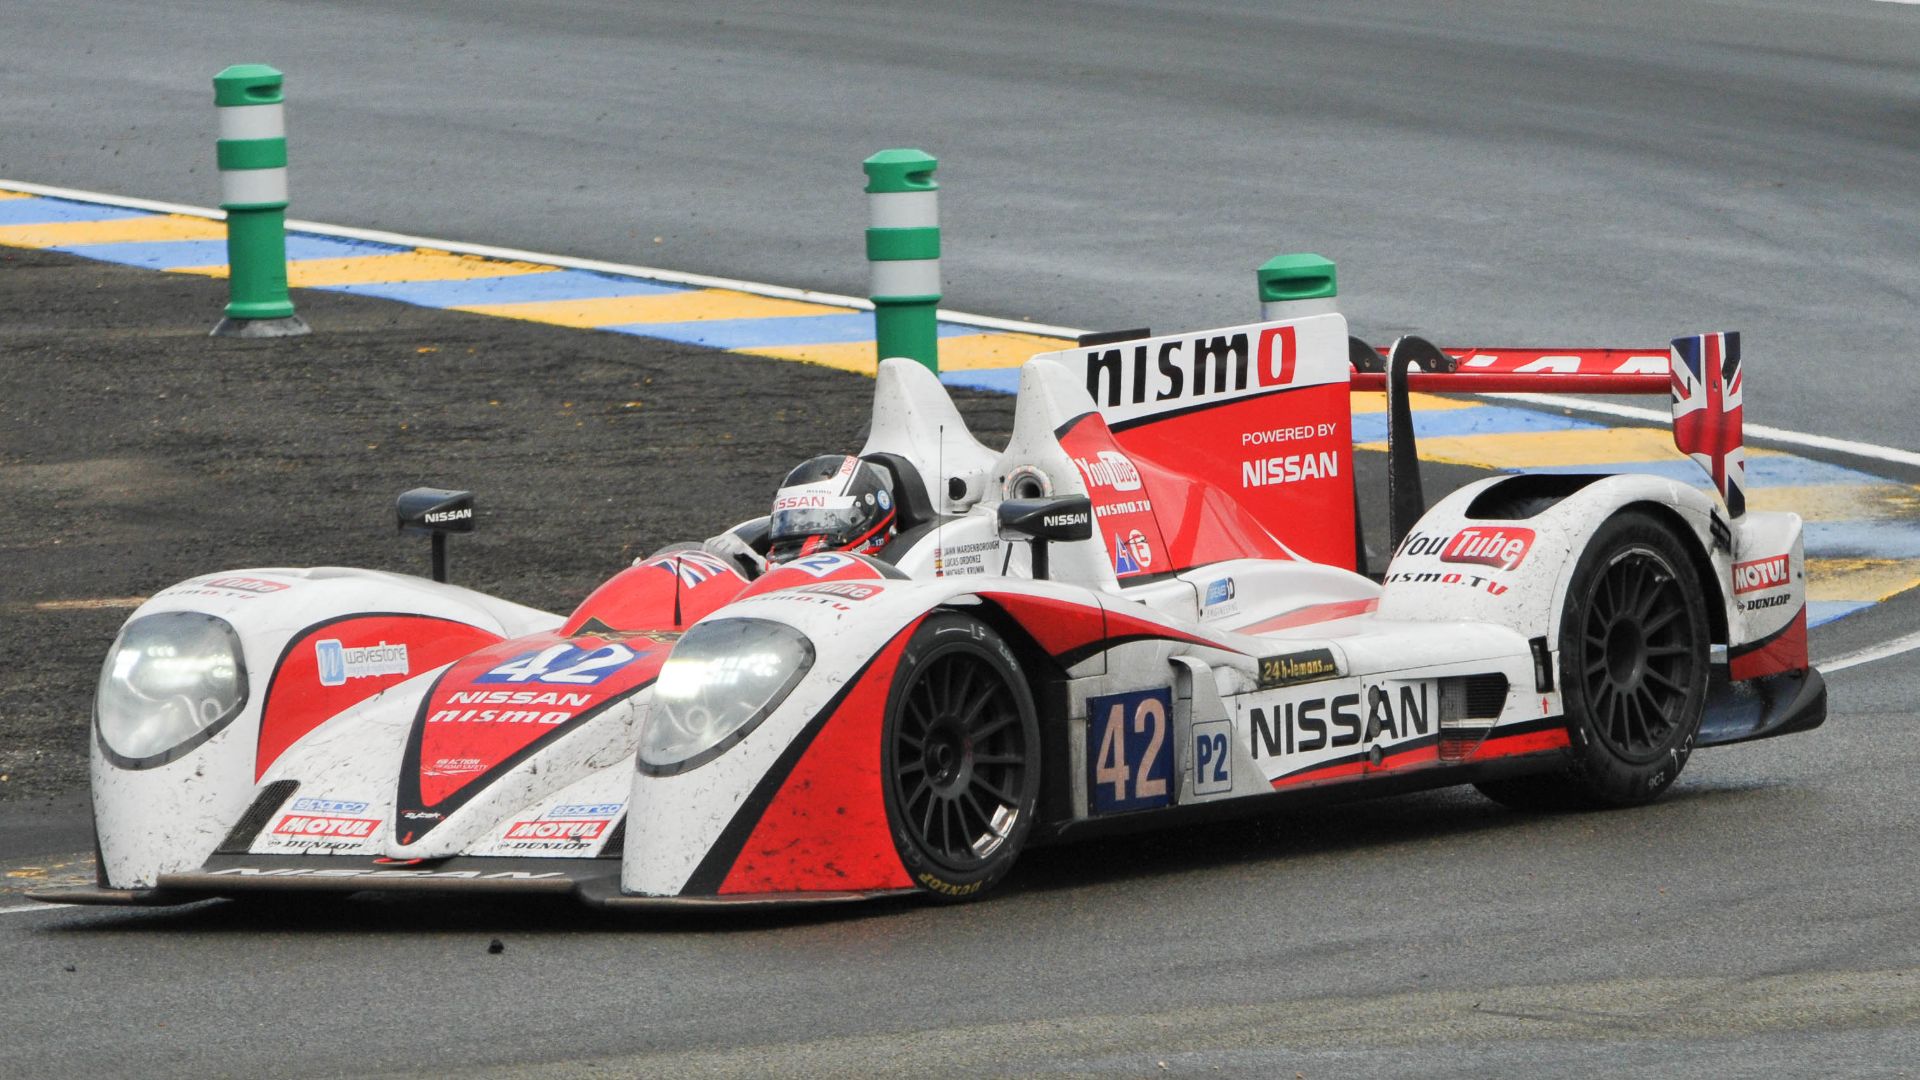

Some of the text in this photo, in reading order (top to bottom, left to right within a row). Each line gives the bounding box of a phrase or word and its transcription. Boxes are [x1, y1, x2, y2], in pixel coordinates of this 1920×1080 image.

[1086, 325, 1297, 408] nismo
[1242, 423, 1336, 446] POWERED BY
[1074, 454, 1139, 489] YouTube
[1242, 451, 1338, 488] NISSAN
[424, 508, 472, 523] NISSAN
[1043, 513, 1088, 527] NISSAN
[1397, 529, 1528, 564] YouTube
[1735, 559, 1787, 590] MOTUL
[1747, 594, 1791, 610] DUNLOP
[345, 645, 406, 665] wavestore
[487, 643, 635, 684] 42
[446, 690, 592, 707] NISSAN
[1250, 682, 1428, 760] NISSAN
[1096, 698, 1167, 801] 42
[1196, 733, 1228, 784] P2
[279, 817, 372, 836] MOTUL
[509, 821, 601, 838] MOTUL
[284, 840, 362, 850] DUNLOP
[511, 841, 592, 850] DUNLOP
[207, 868, 565, 879] NISSAN
